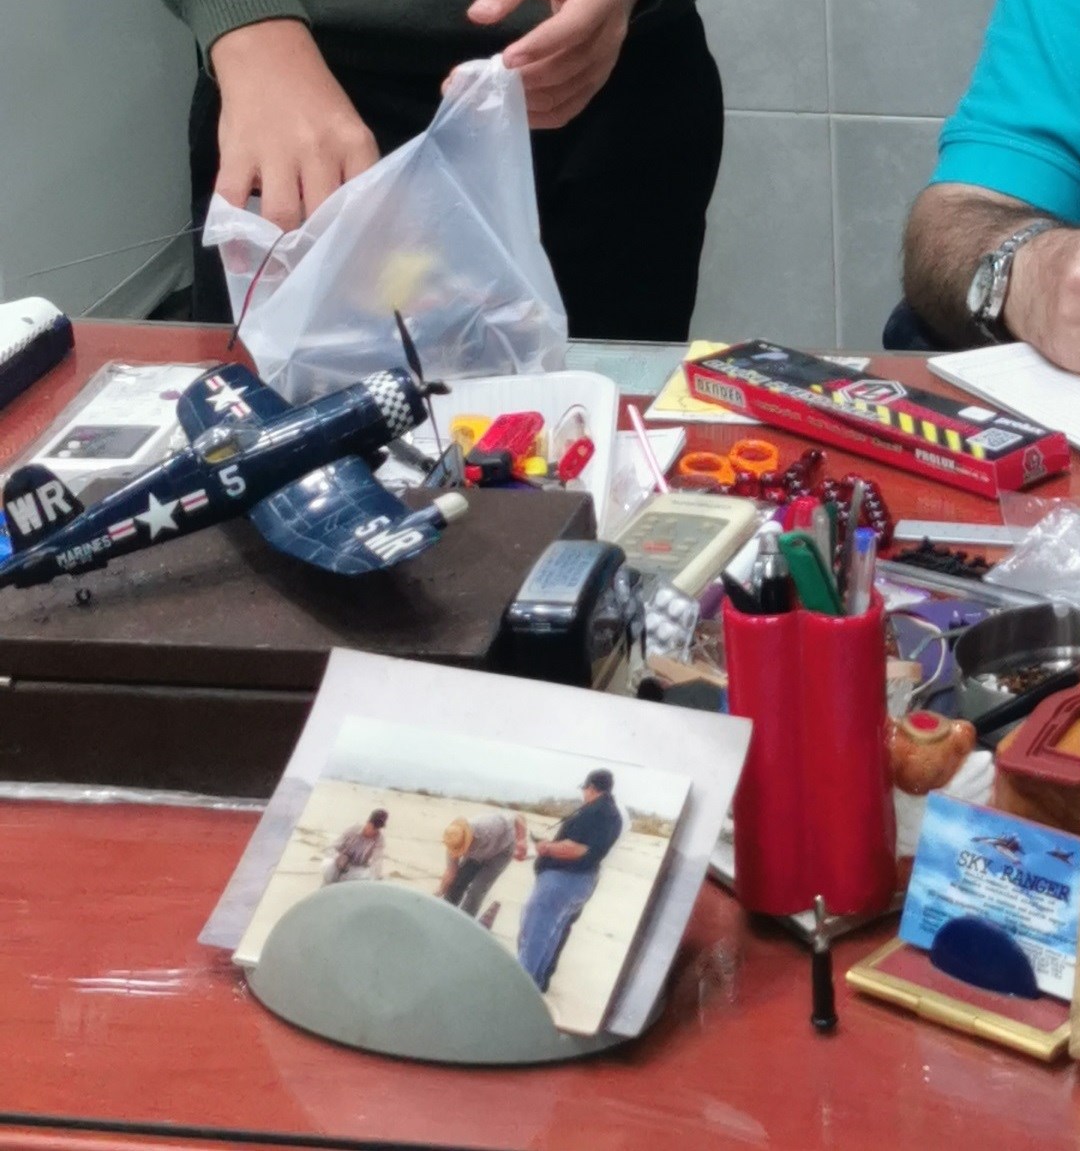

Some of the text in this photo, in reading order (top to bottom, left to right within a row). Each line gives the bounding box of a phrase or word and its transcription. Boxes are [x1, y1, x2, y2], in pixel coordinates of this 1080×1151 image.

[914, 448, 956, 470] PROLUX
[219, 464, 247, 497] 5
[6, 479, 73, 537] WR
[56, 534, 113, 565] MARINES
[956, 848, 994, 875] SKY
[1000, 863, 1072, 904] RANGER
